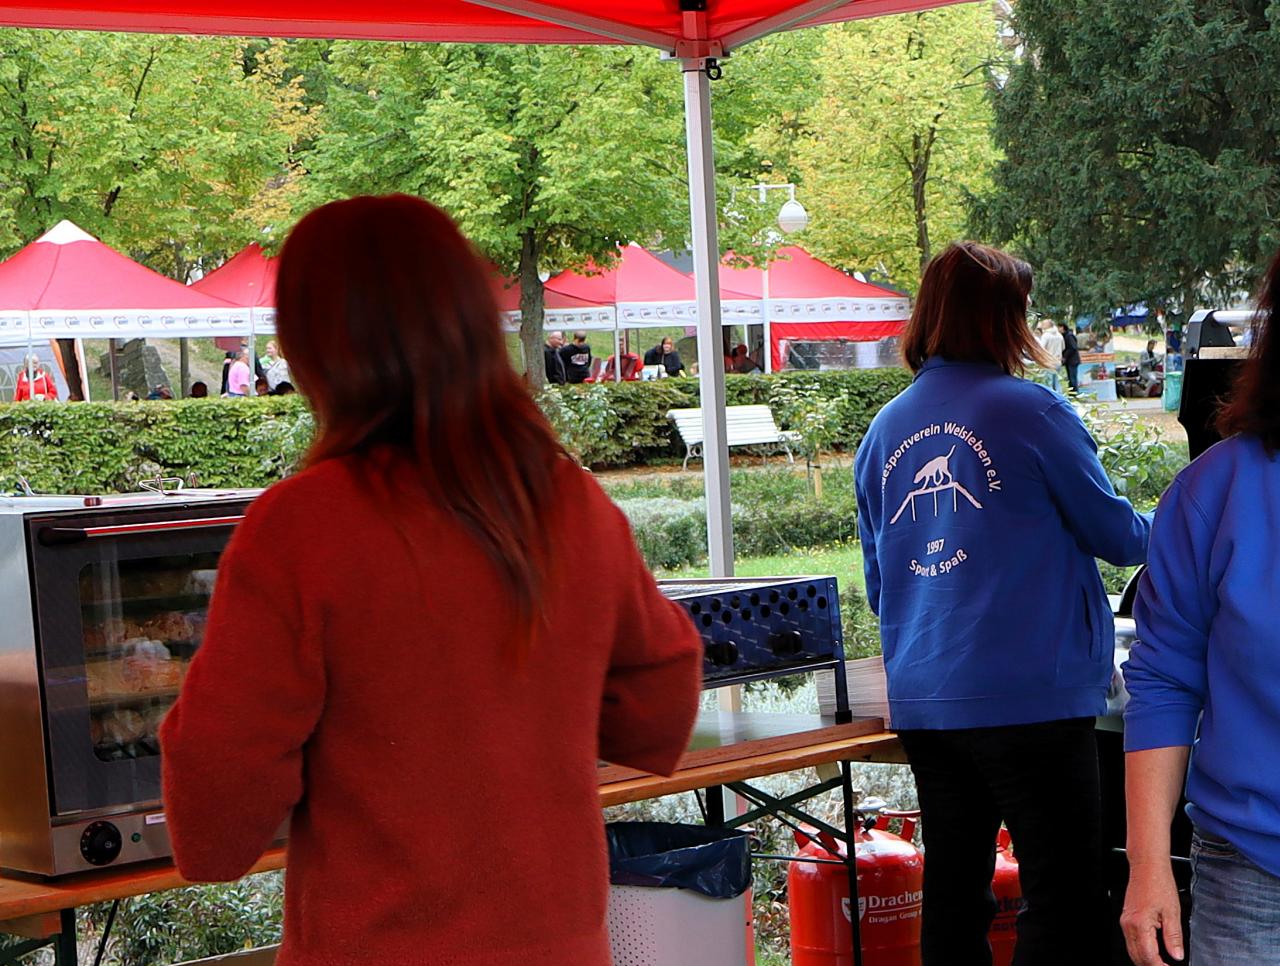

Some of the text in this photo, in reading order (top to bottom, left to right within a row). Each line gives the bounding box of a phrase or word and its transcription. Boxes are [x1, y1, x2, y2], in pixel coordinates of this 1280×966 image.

[926, 538, 945, 556] 1997
[930, 563, 938, 577] &
[939, 549, 968, 574] Spaß
